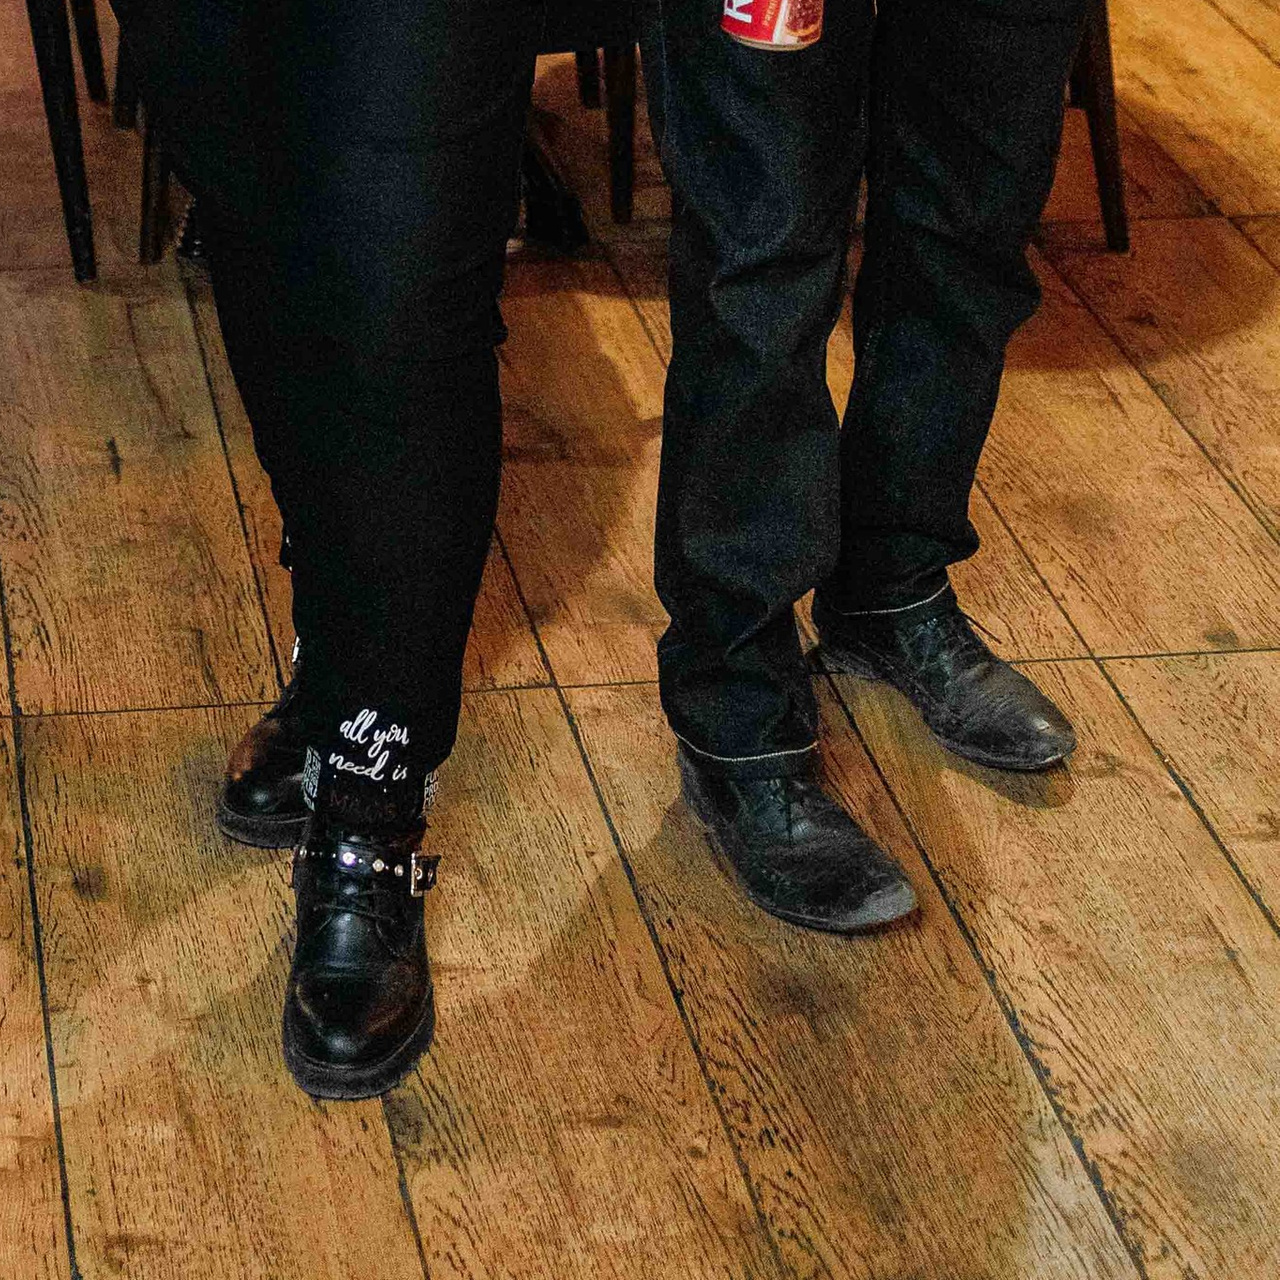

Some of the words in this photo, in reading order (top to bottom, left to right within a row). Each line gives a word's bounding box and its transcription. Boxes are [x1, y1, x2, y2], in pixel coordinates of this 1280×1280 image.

[340, 708, 377, 744] all
[368, 724, 410, 758] you
[328, 750, 389, 780] need
[392, 764, 408, 780] is
